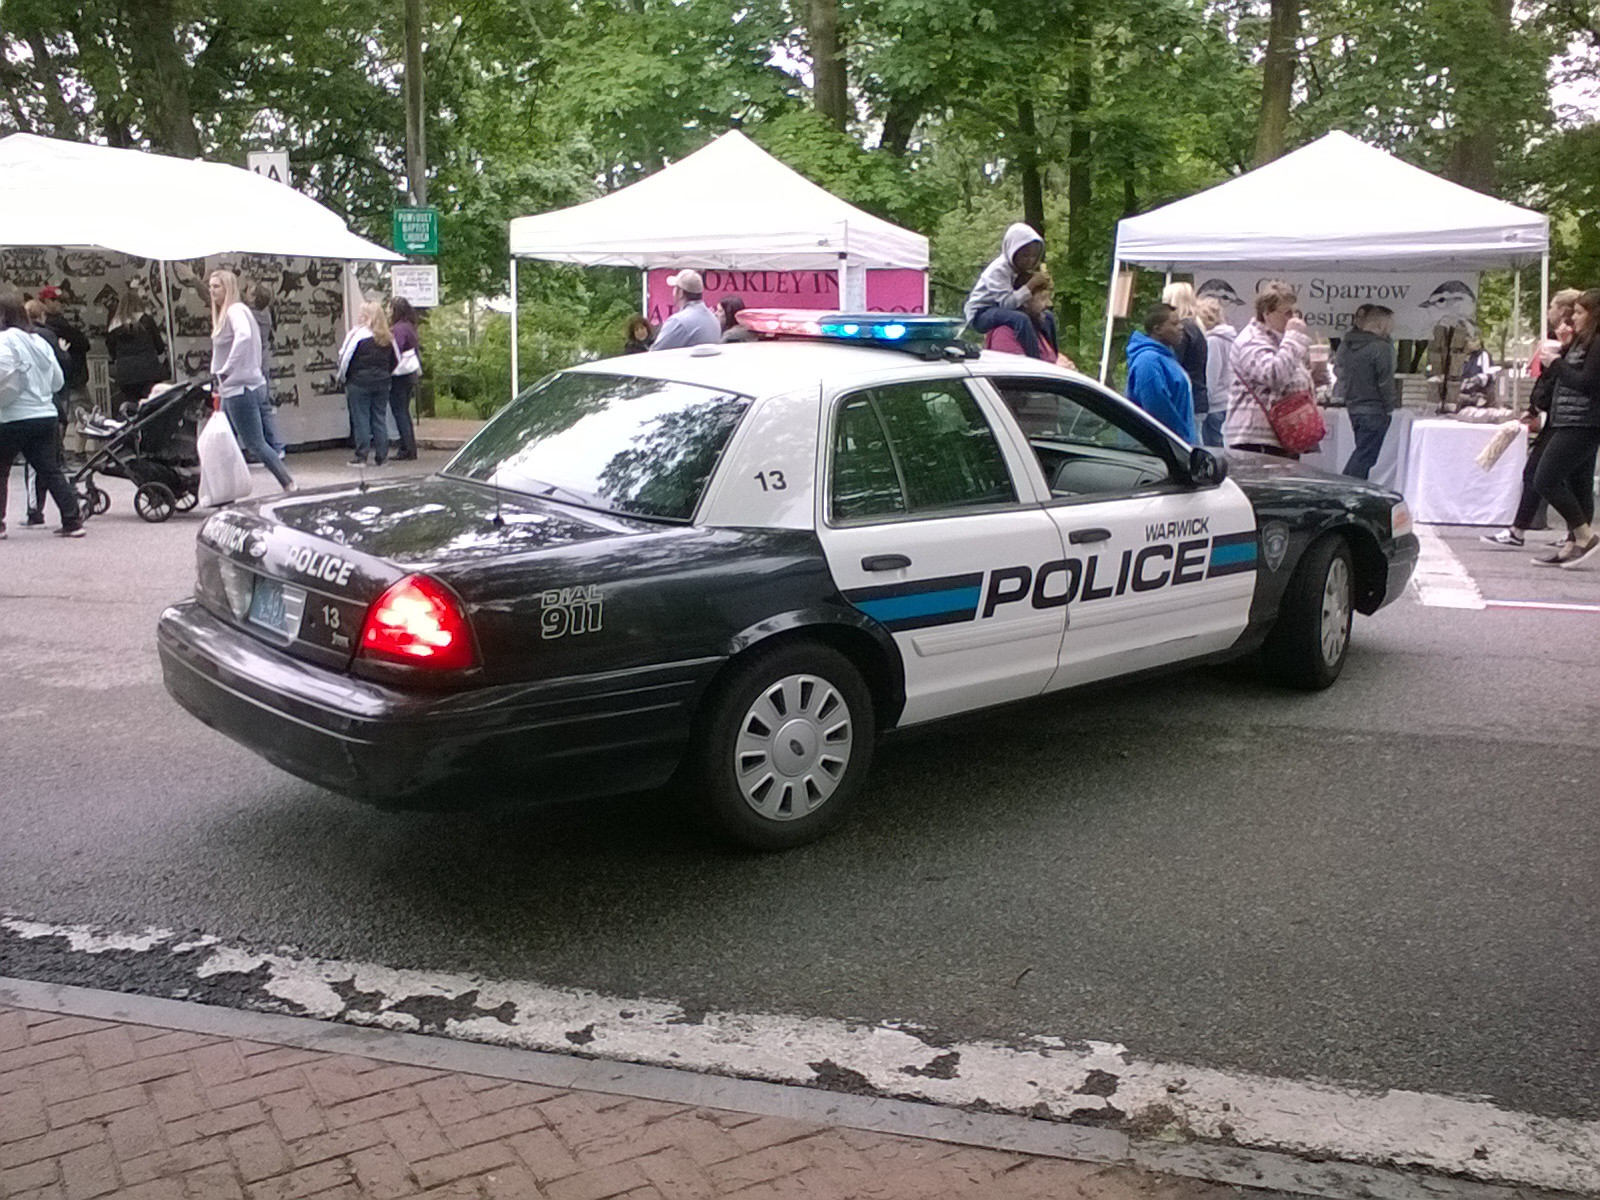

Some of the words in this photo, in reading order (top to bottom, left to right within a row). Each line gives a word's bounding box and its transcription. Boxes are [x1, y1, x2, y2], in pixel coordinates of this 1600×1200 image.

[702, 271, 805, 294] OAKLEY
[1309, 278, 1411, 304] Sparrow
[1298, 306, 1355, 331] esig
[753, 470, 788, 492] 13
[1145, 516, 1210, 542] WARWICK
[286, 544, 356, 586] POLICE
[982, 539, 1210, 619] POLICE
[541, 584, 604, 609] DIAL
[322, 604, 340, 629] 13
[541, 600, 603, 640] 911
